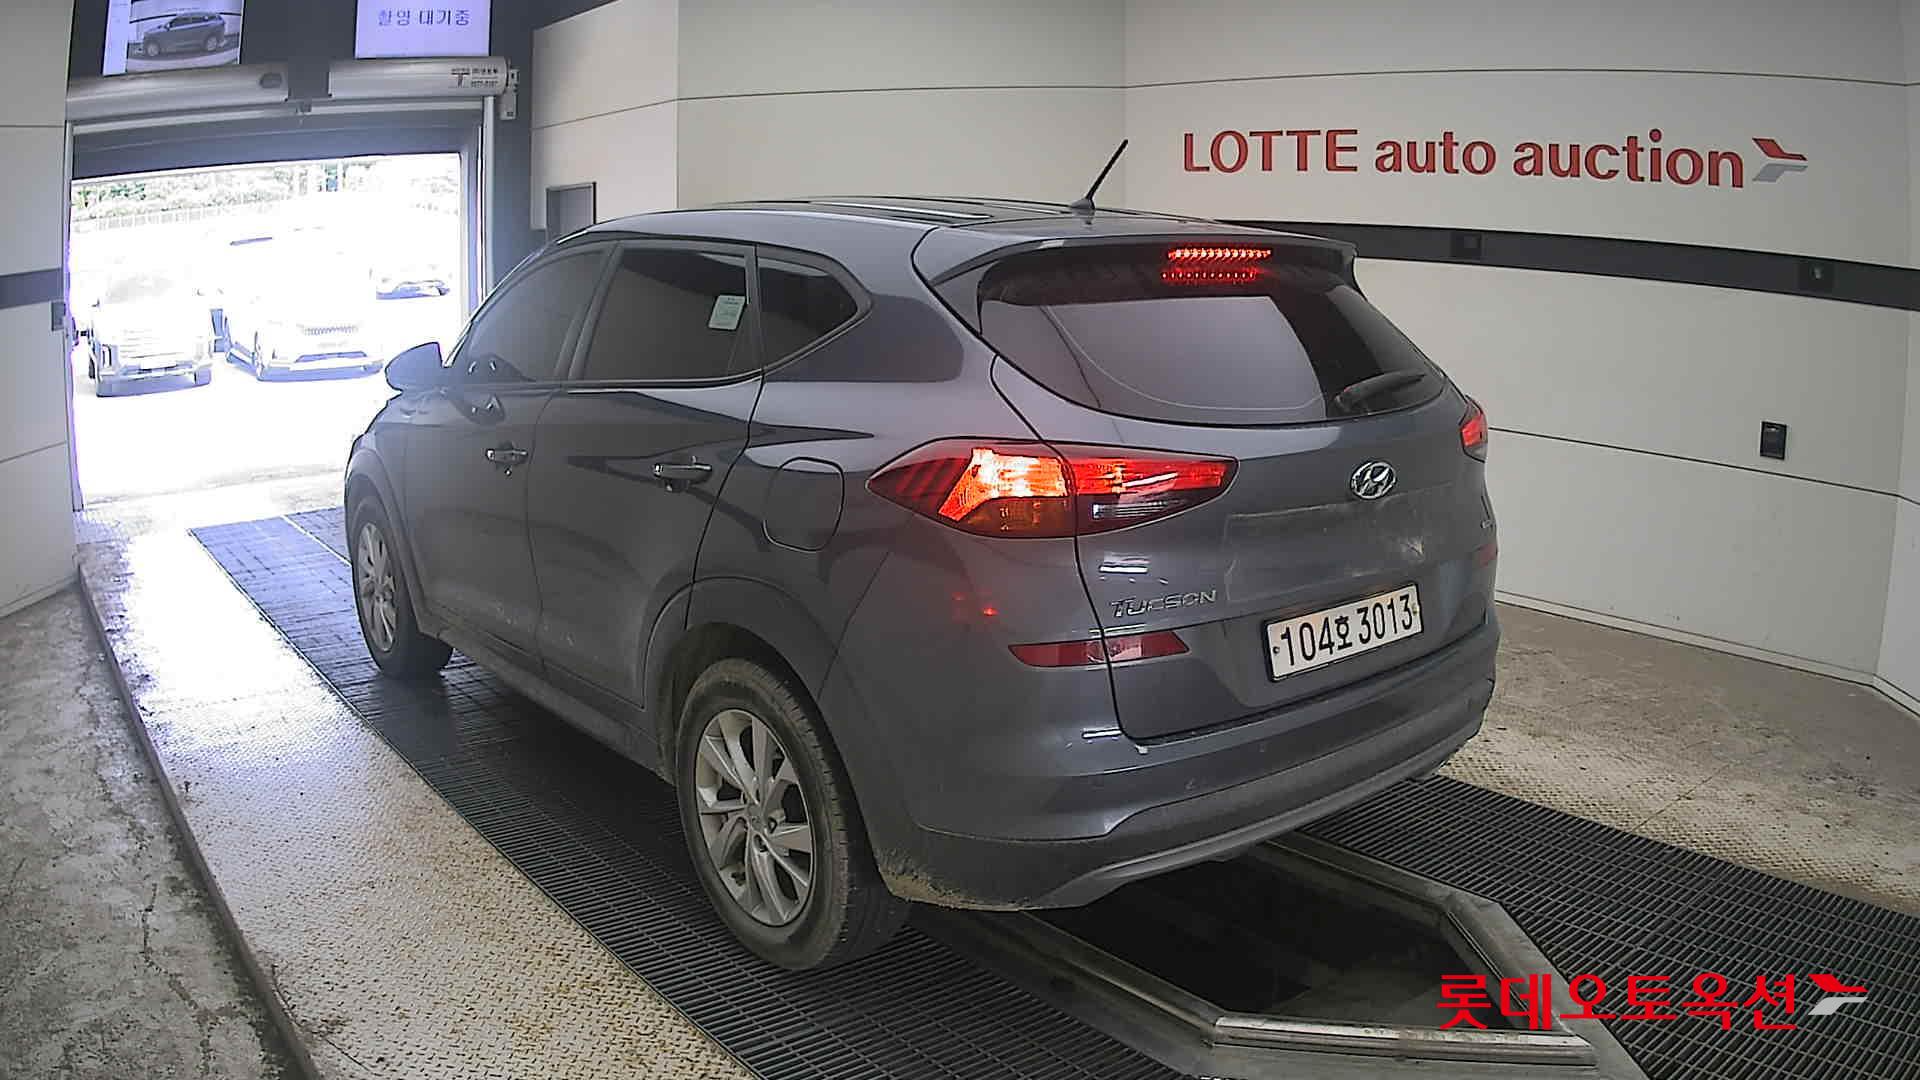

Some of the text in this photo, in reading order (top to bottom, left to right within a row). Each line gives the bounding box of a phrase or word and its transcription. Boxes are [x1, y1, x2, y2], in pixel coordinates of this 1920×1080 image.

[418, 9, 471, 26] 대기중
[1183, 128, 1744, 189] LOTTE auto auction
[1111, 589, 1217, 617] TUCSON
[1280, 593, 1413, 666] 104호 3013
